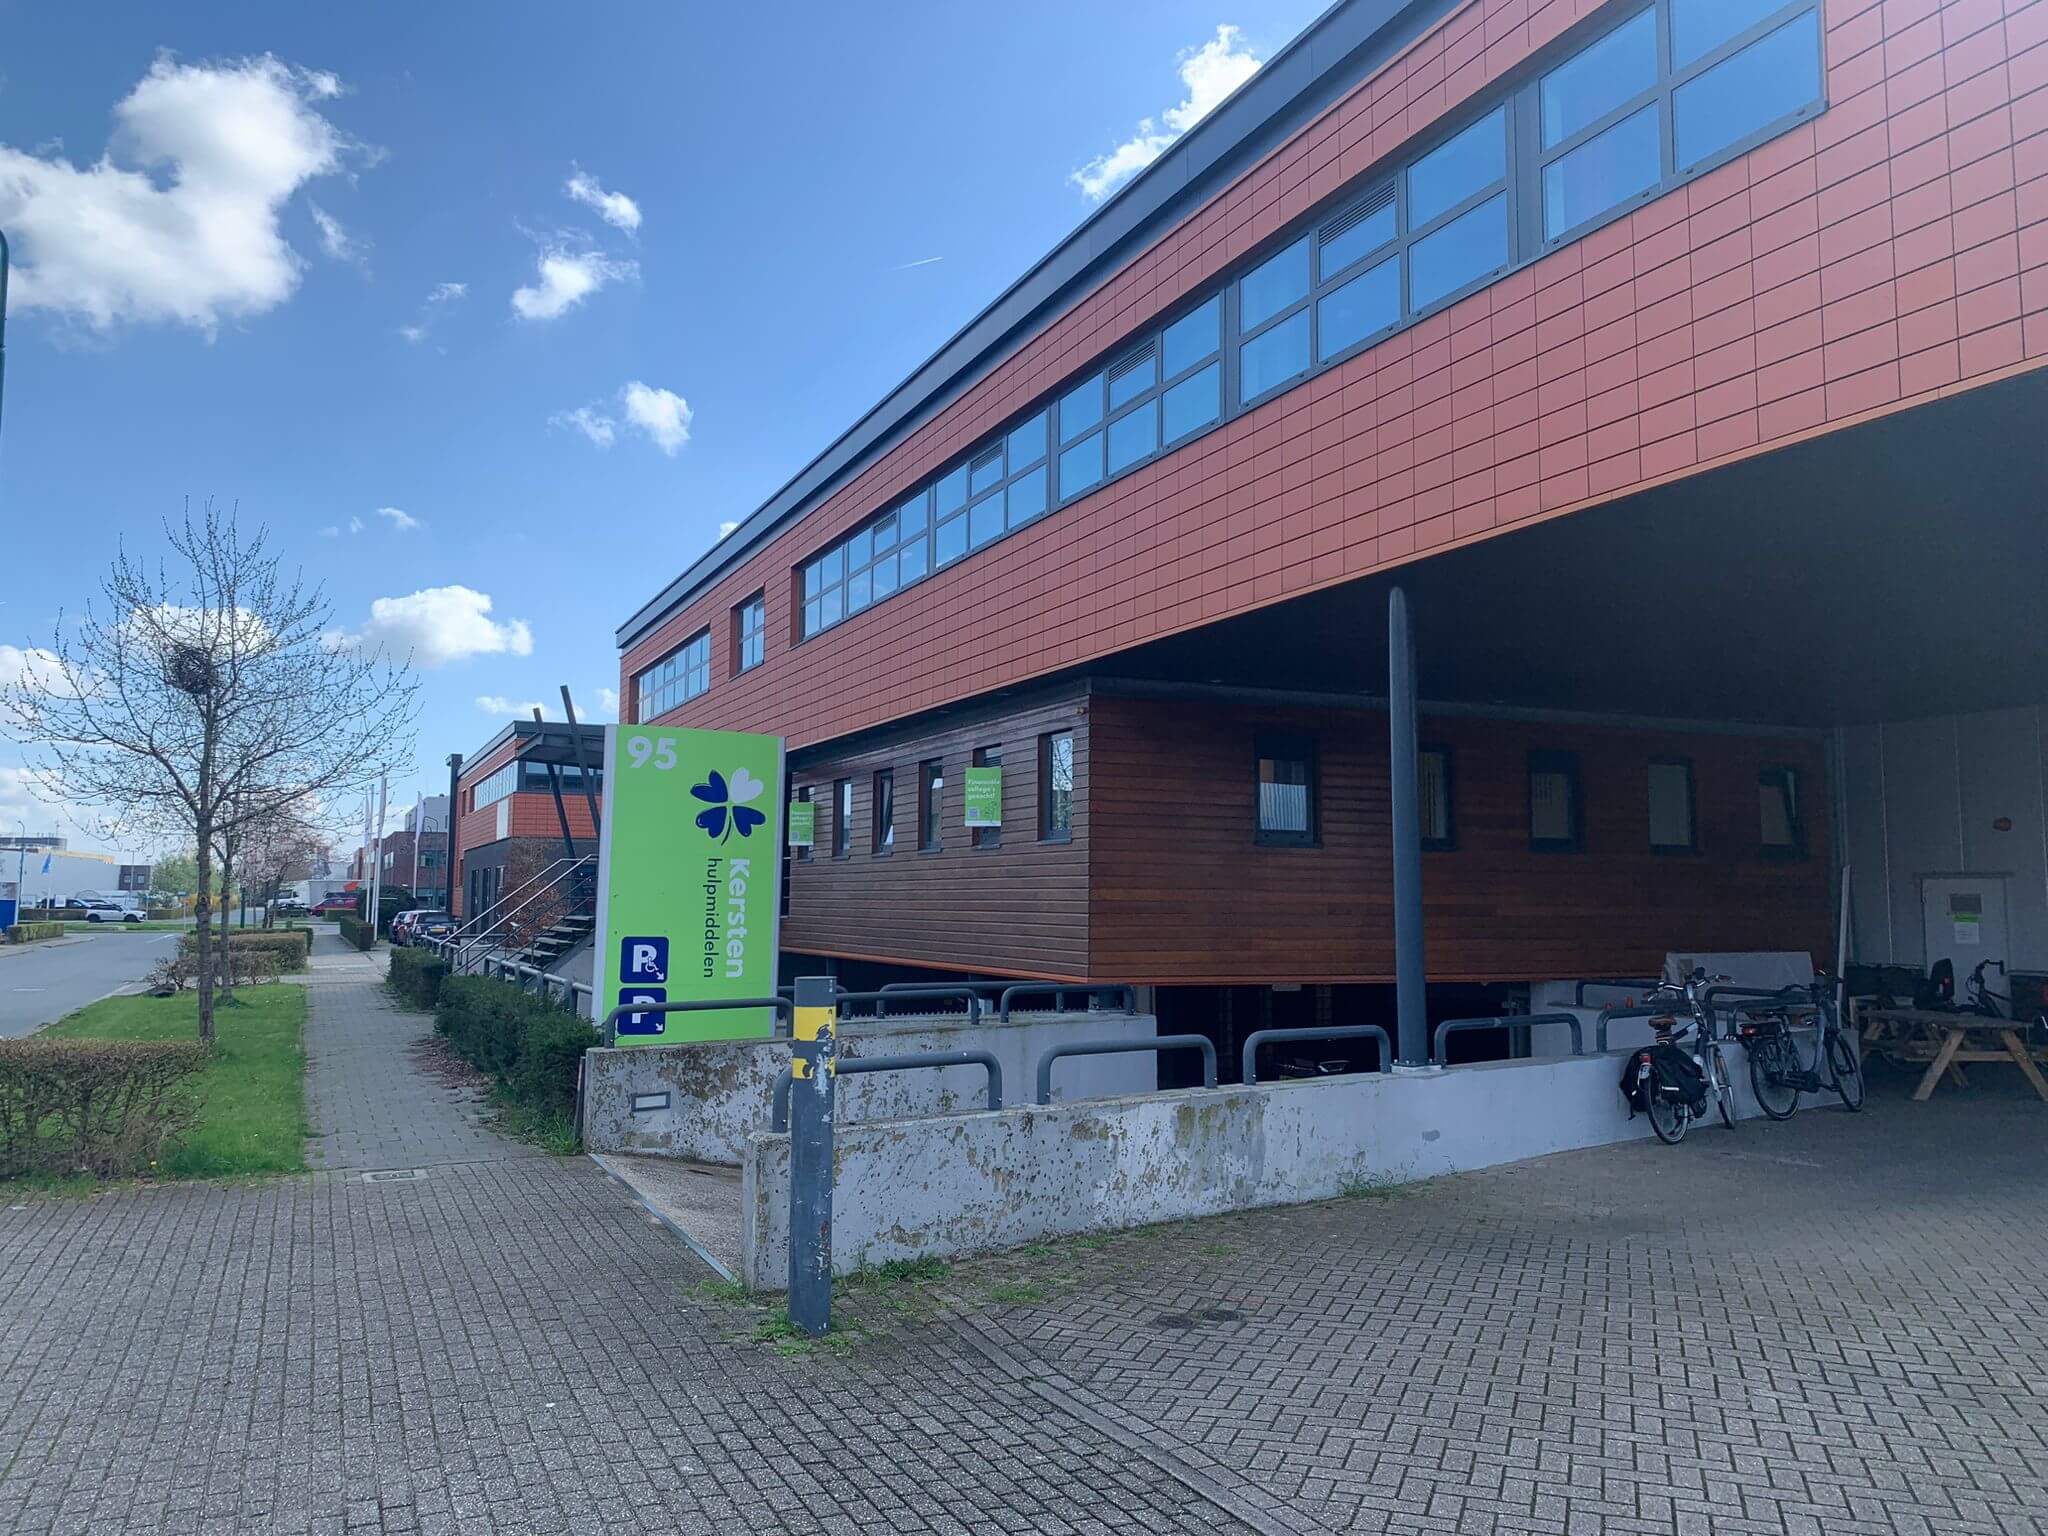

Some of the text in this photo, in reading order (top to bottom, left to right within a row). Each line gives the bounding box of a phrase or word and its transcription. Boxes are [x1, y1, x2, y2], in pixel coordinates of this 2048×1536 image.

[627, 736, 677, 770] 95
[703, 858, 723, 978] hulpmiddelen
[725, 858, 750, 978] Kersten
[632, 944, 657, 973] P
[631, 995, 656, 1024] P
